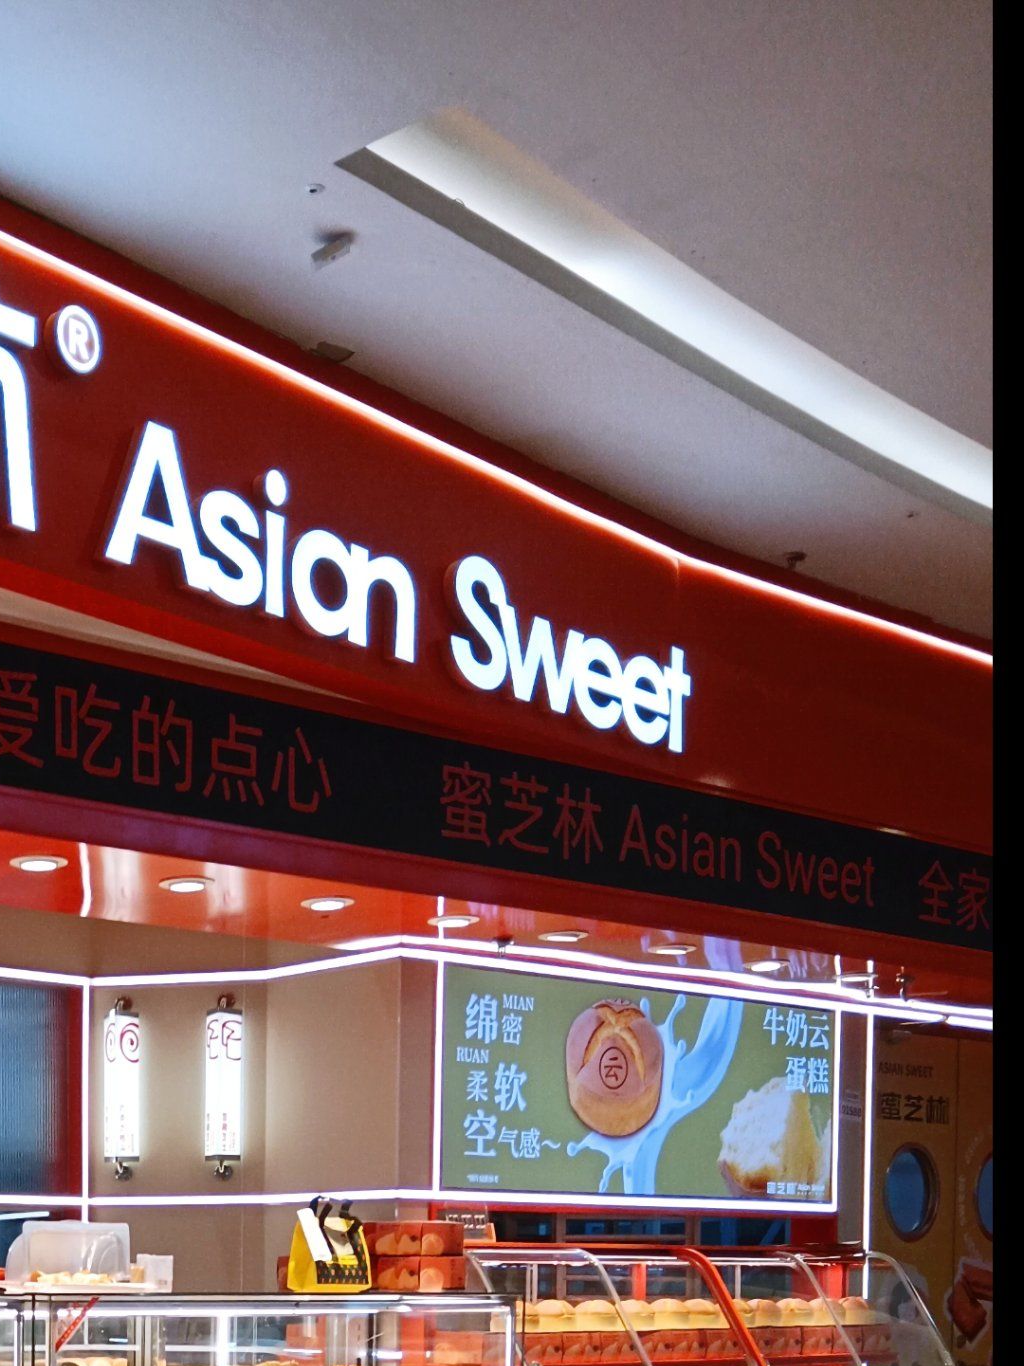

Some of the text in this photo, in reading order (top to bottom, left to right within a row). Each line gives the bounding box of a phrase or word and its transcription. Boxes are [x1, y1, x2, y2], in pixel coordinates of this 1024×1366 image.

[104, 421, 692, 754] Asian Sweet
[439, 761, 875, 907] 蜜芝林 Asian Sweet
[502, 994, 534, 1012] MIAN
[763, 1007, 829, 1050] 牛奶云
[456, 1046, 490, 1064] RUAN
[905, 1064, 934, 1079] SWEET
[785, 1056, 829, 1094] 蛋糕
[880, 1091, 949, 1125] 蜜芝林
